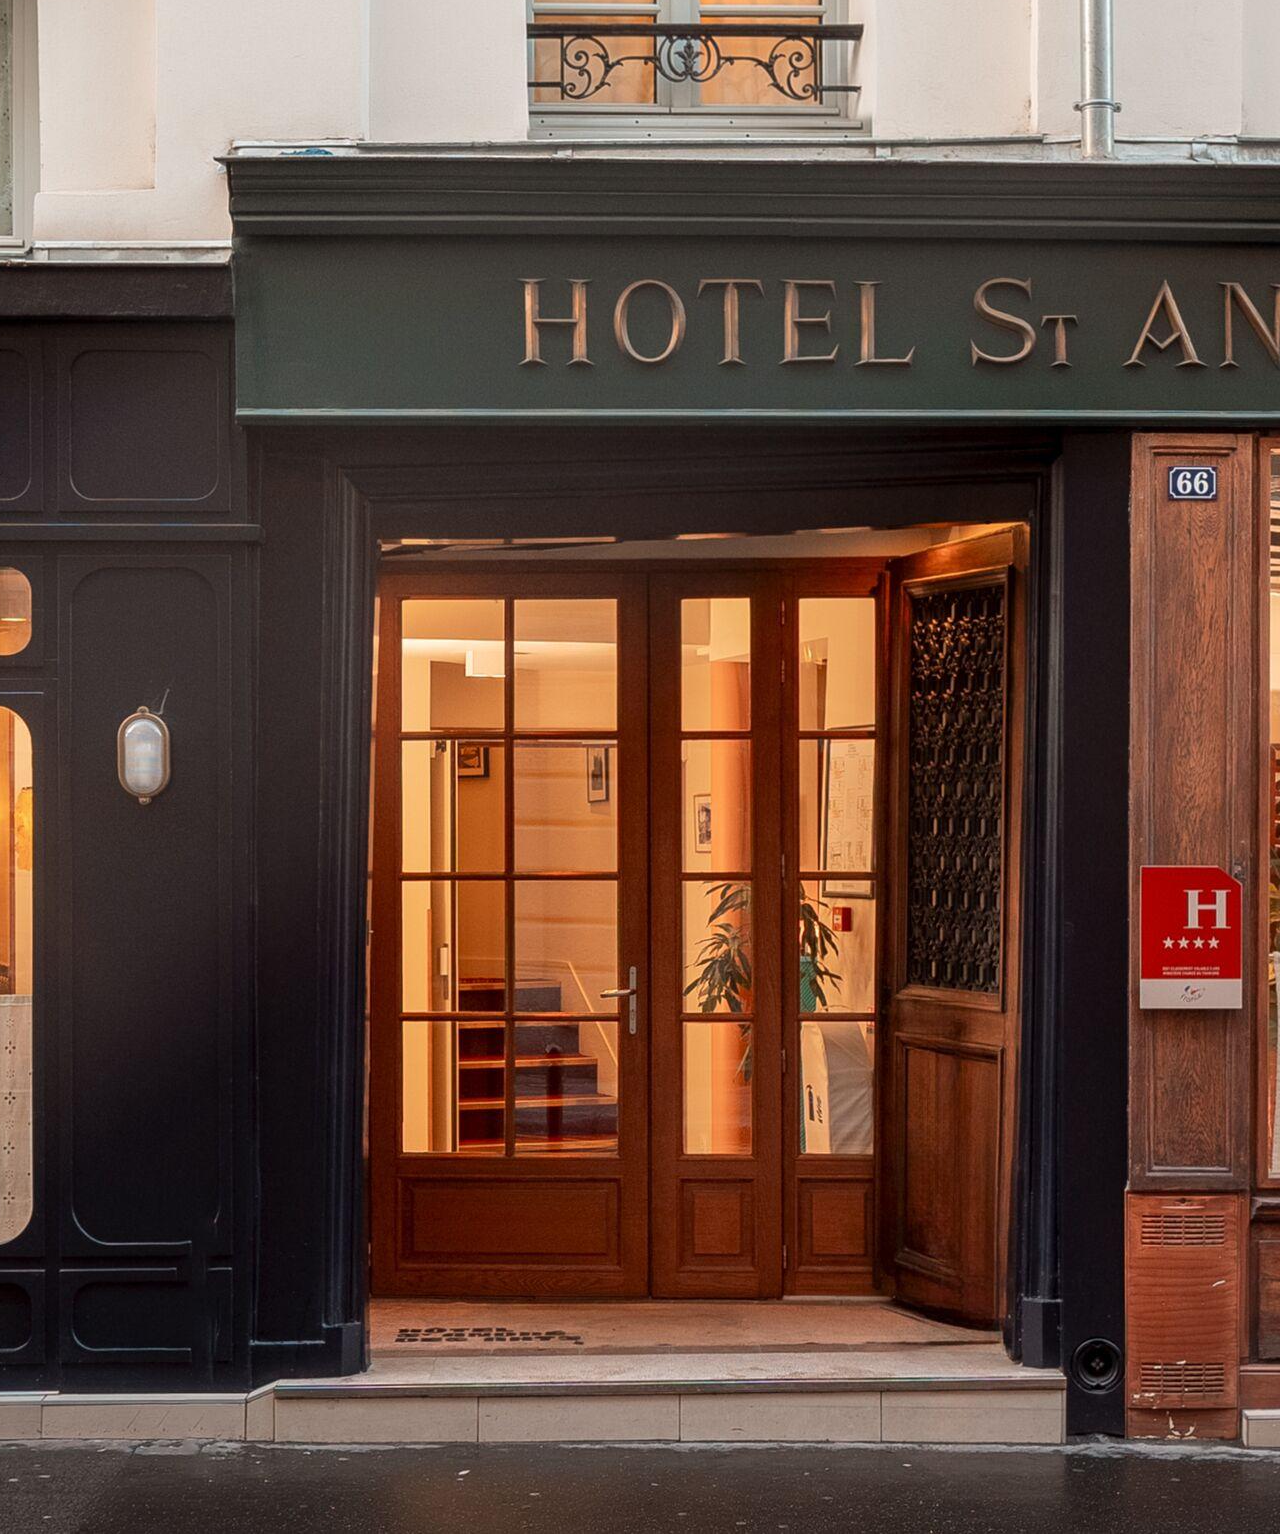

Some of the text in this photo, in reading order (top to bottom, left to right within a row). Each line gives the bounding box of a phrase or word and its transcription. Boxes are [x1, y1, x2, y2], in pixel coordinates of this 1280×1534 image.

[518, 277, 915, 367] HOTEL
[1176, 471, 1209, 494] 66
[1182, 889, 1232, 929] H
